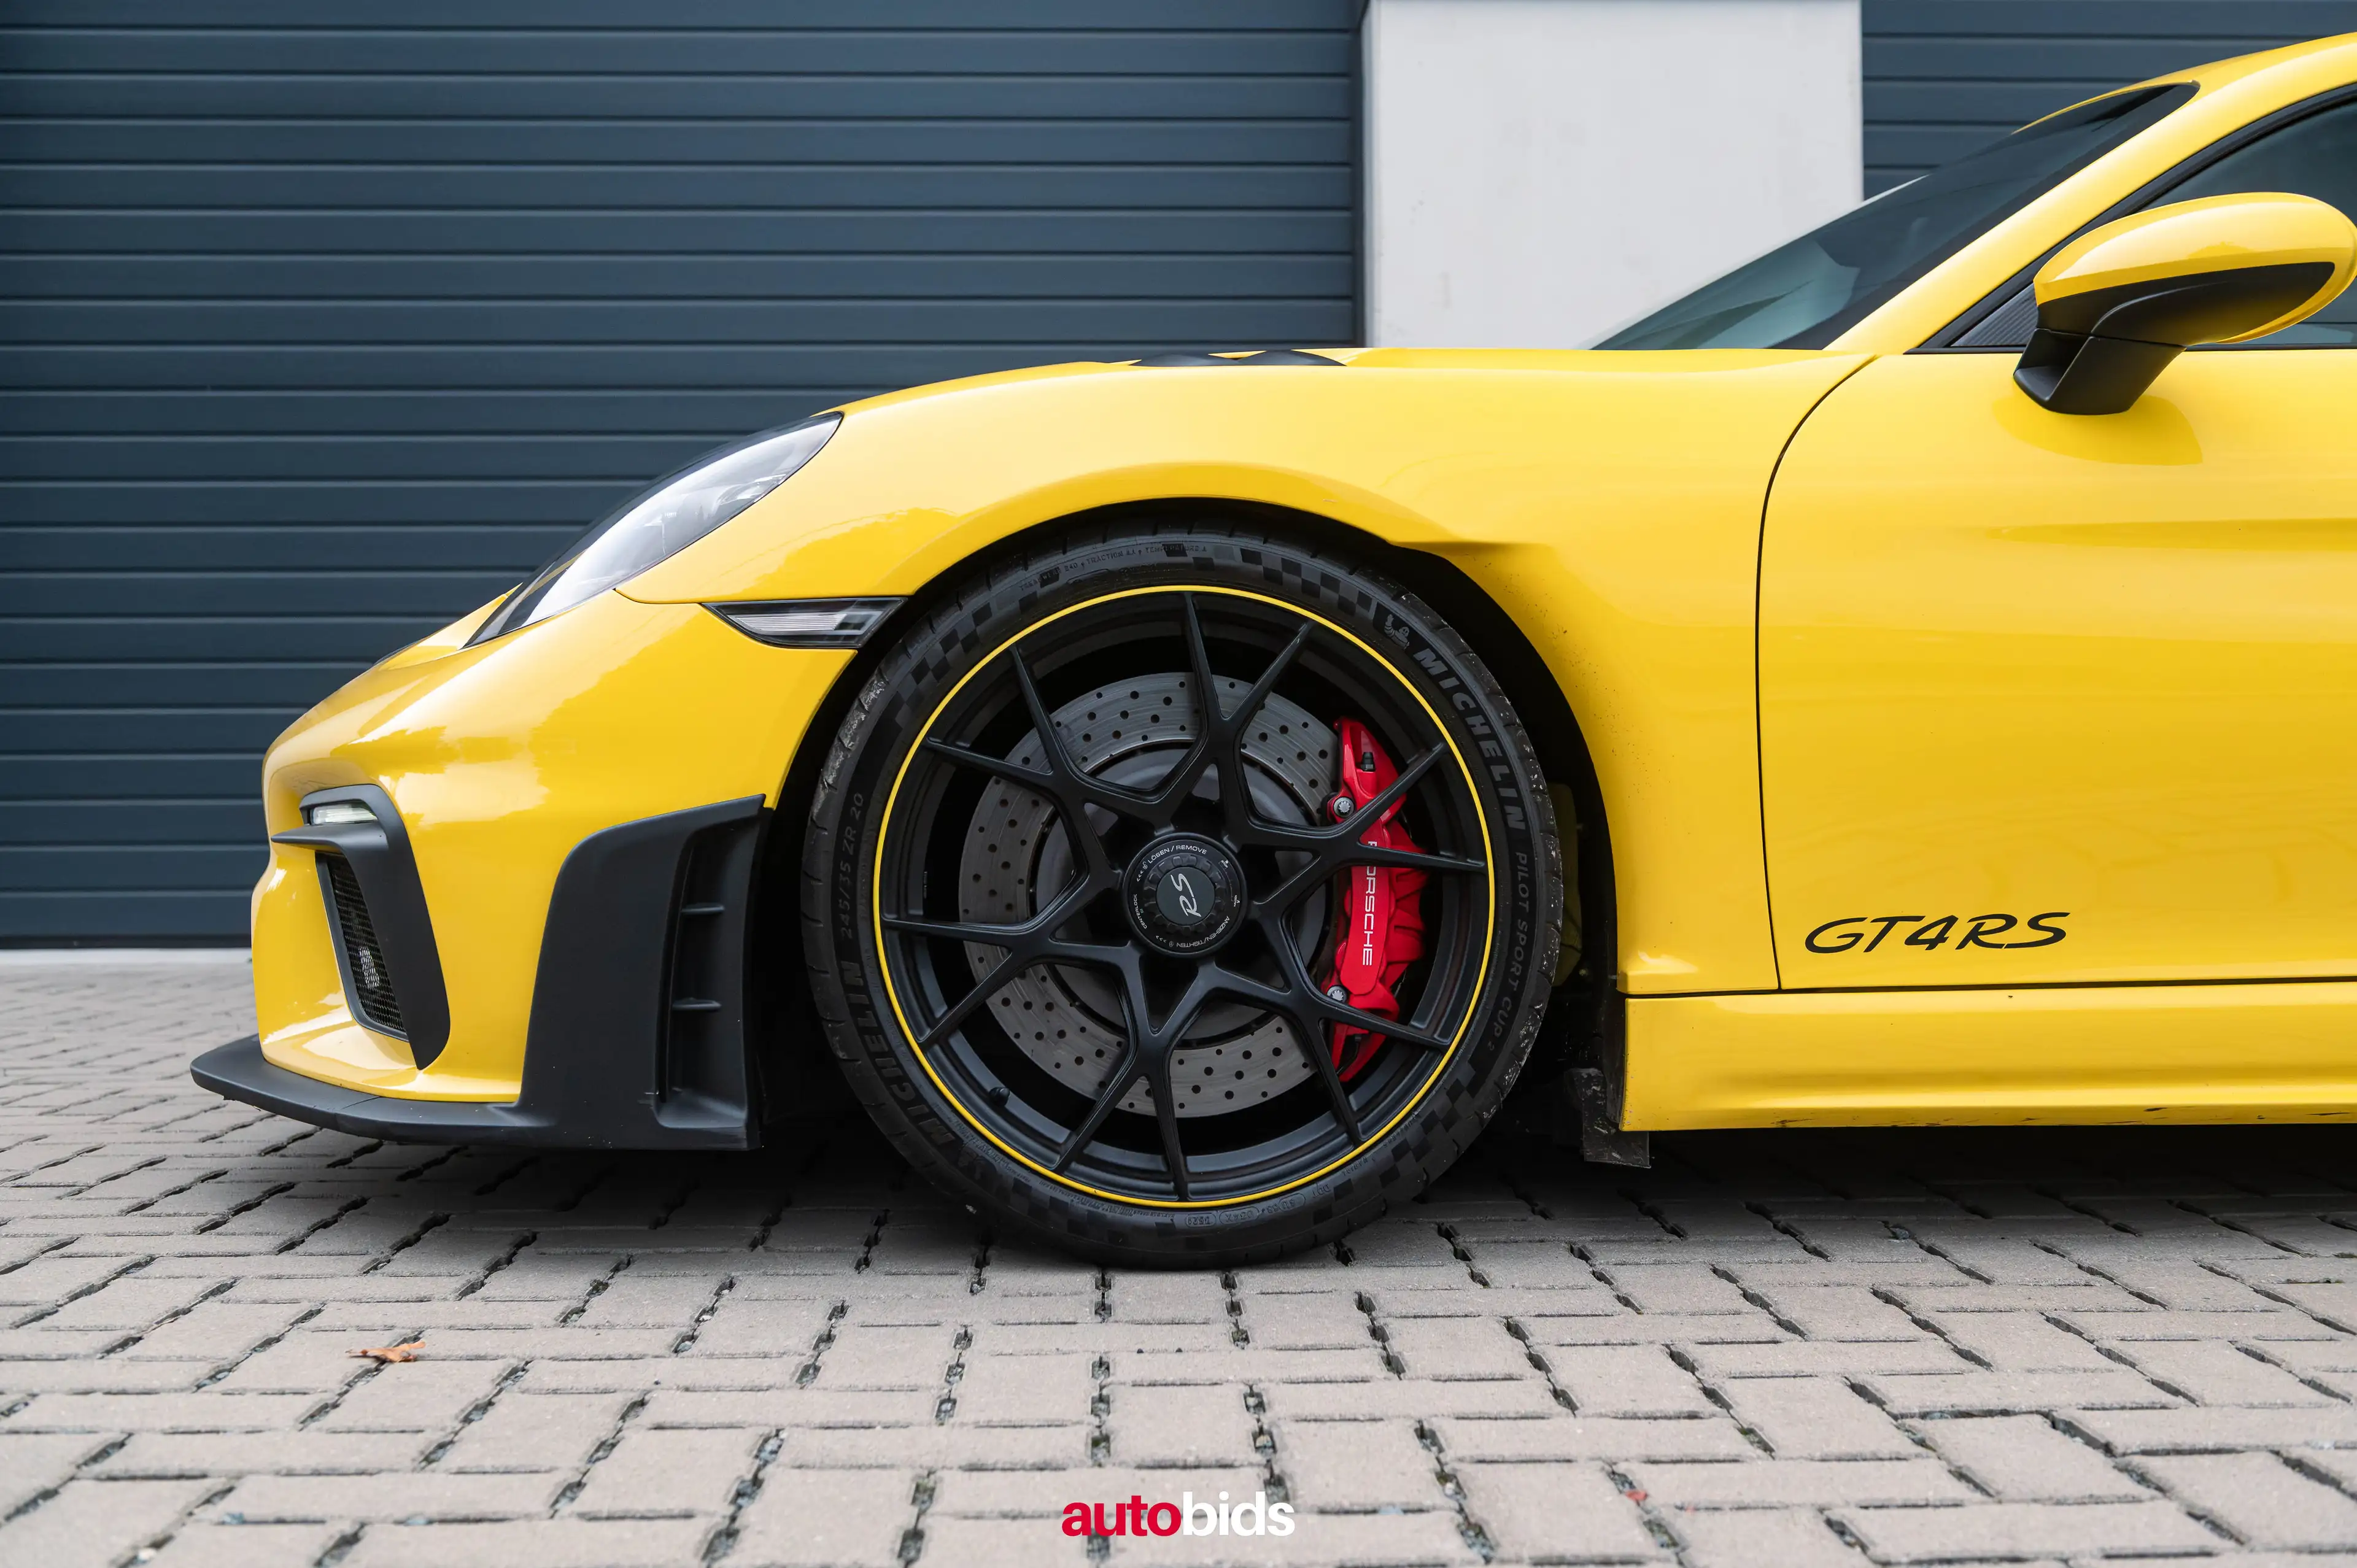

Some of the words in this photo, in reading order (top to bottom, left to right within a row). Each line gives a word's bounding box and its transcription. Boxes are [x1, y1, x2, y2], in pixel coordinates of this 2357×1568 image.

[1086, 552, 1124, 565] TRACTION
[1413, 647, 1528, 831] MICHELIN
[846, 790, 867, 822] 20
[840, 825, 858, 855] ZR
[1148, 847, 1170, 863] LÖSEN
[1175, 844, 1207, 855] REMOVE
[837, 859, 854, 940] 245/35
[1170, 873, 1202, 917] RS
[1515, 850, 1530, 913] PILOT
[1132, 894, 1147, 929] CENTERLOCK
[1507, 919, 1530, 991] SPORT
[1492, 997, 1515, 1039] CUP
[841, 960, 955, 1149] MICHELIN
